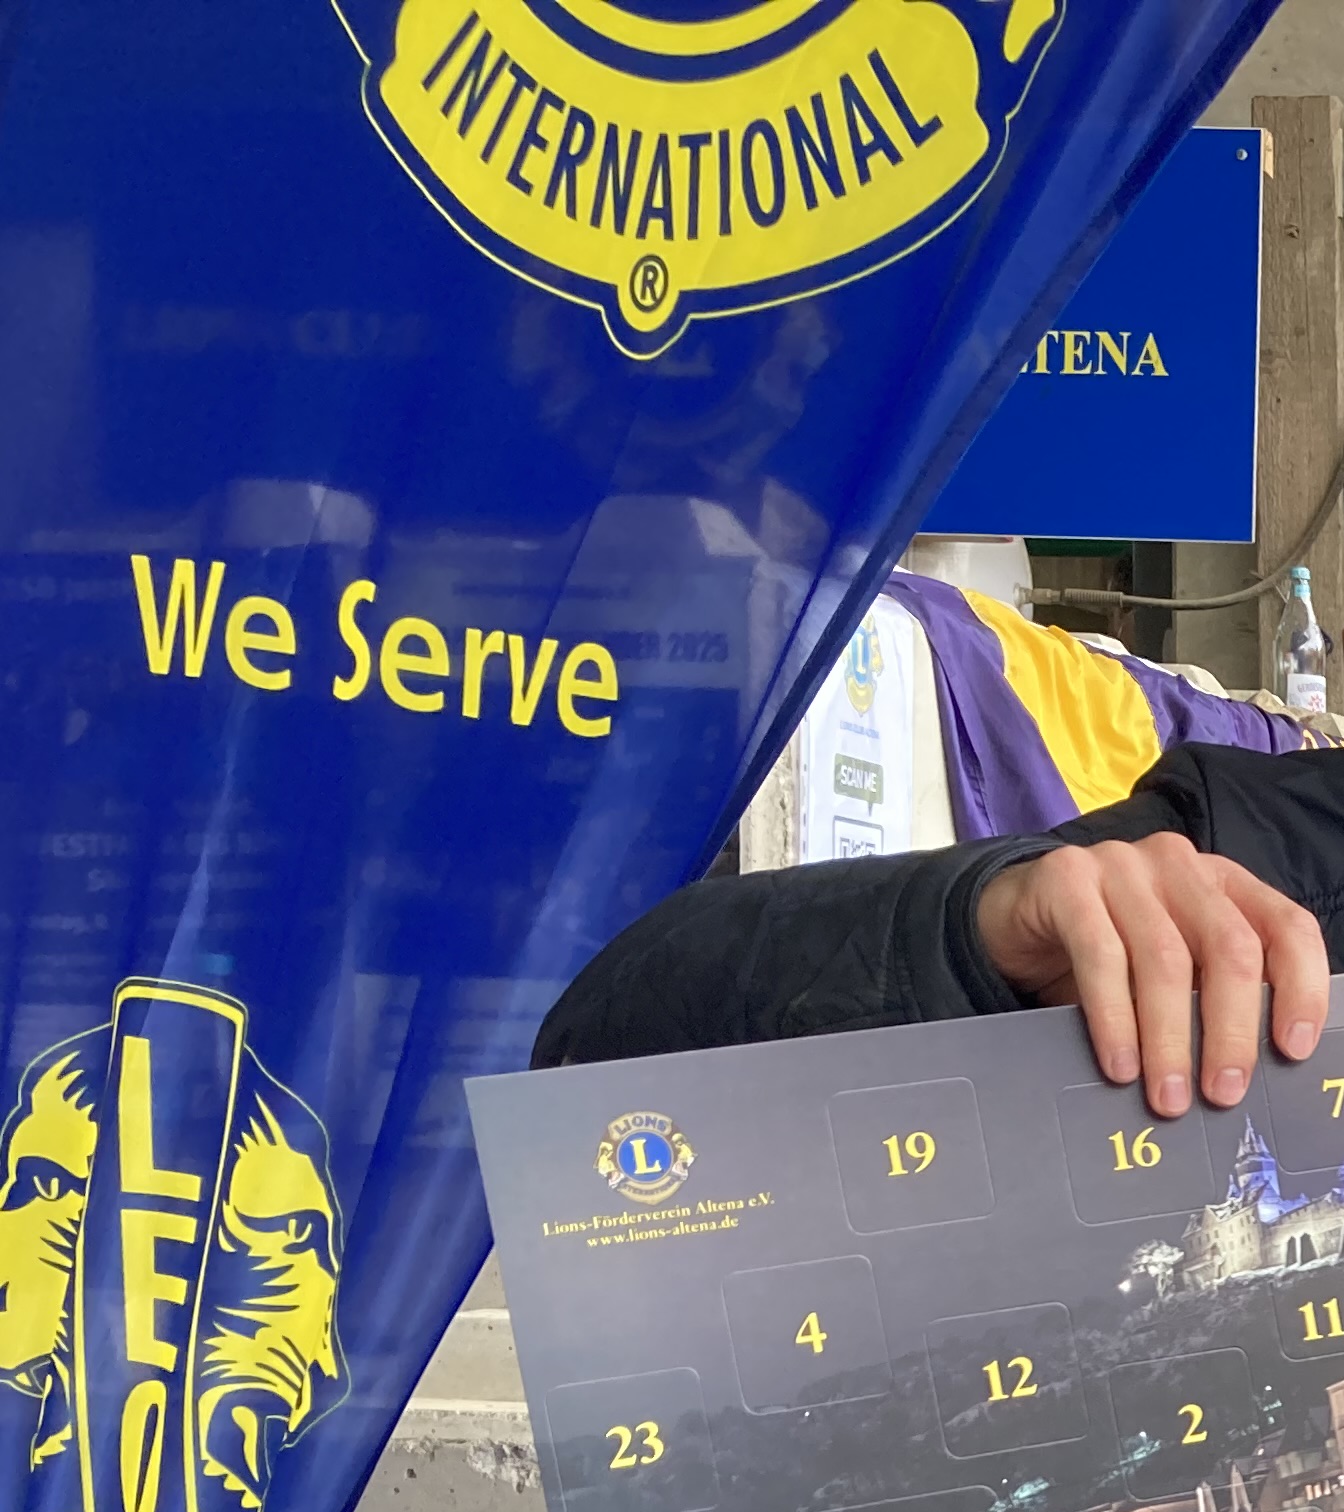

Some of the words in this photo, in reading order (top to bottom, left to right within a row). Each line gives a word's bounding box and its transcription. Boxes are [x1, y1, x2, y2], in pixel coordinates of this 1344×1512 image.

[421, 10, 943, 242] INTERNATIONAL
[1020, 330, 1169, 377] TENA
[130, 553, 297, 691] We
[331, 578, 619, 738] Serve
[630, 1139, 662, 1174] L
[883, 1131, 935, 1176] 19
[1109, 1127, 1161, 1171] 16
[543, 1207, 691, 1236] Lions-Förderverein
[695, 1199, 744, 1215] Altena
[748, 1192, 775, 1207] e.V.
[587, 1214, 739, 1248] www.lions-altena.de
[796, 1311, 827, 1354] 4
[982, 1356, 1037, 1402] 12
[605, 1422, 664, 1470] 23
[1178, 1404, 1207, 1446] 2
